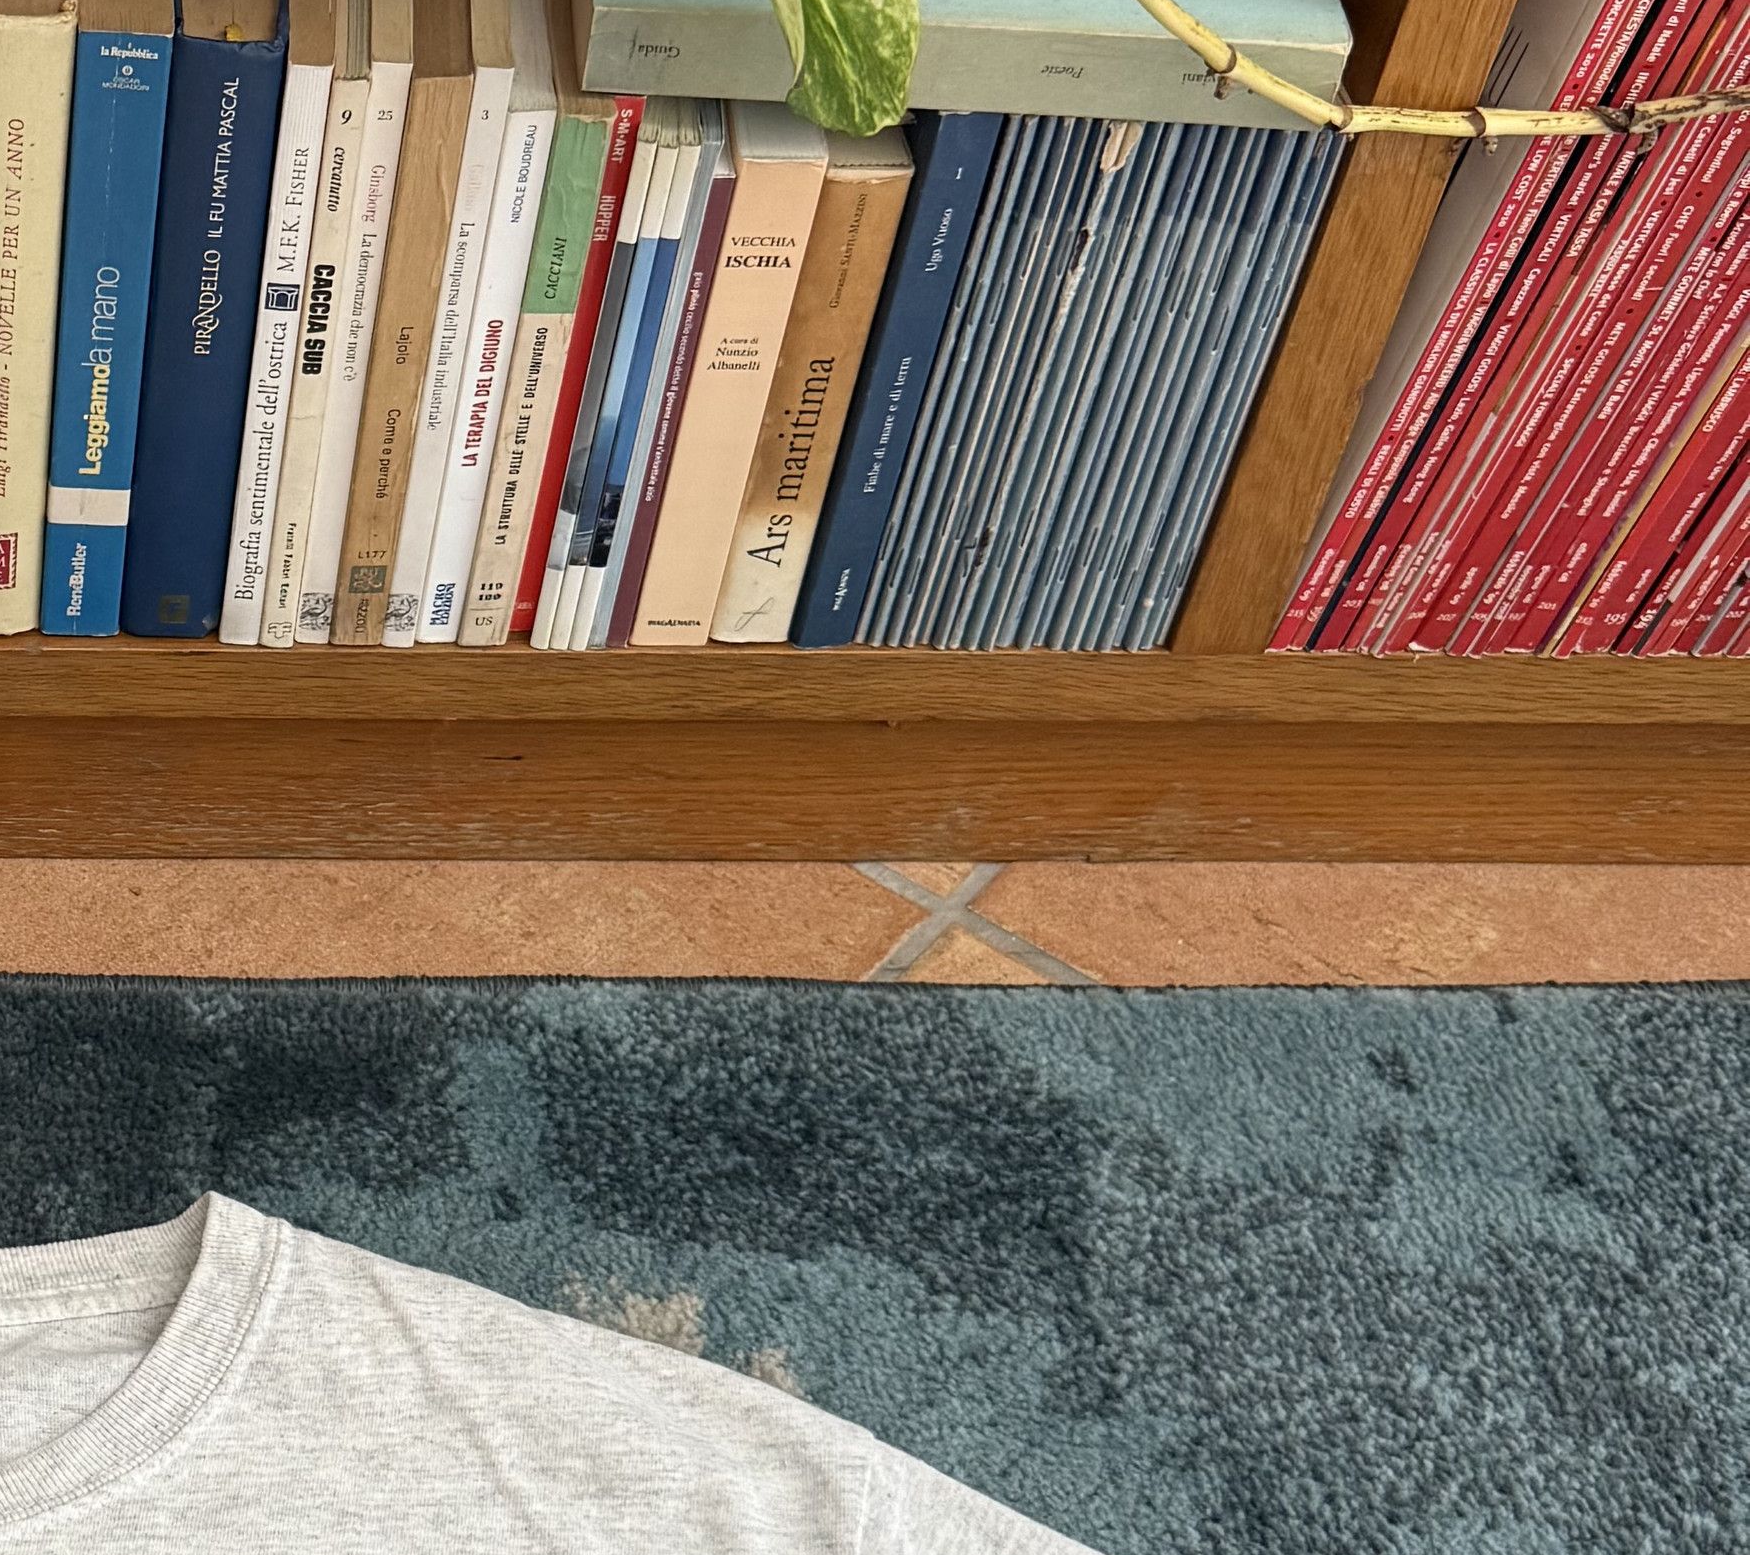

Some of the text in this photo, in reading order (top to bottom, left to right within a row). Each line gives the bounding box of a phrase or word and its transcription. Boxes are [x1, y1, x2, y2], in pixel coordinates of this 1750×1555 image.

[1666, 16, 1679, 26] di
[637, 42, 681, 60] Guida
[1646, 30, 1674, 62] Natale
[1040, 62, 1085, 81] Poesie
[1576, 52, 1595, 78] 2010
[340, 109, 353, 126] 9
[377, 109, 393, 121] 25
[6, 118, 24, 180] ANNO
[4, 187, 21, 216] UN
[192, 78, 240, 354] PIRANDELLO IL FU MATTIA PASCAL
[2, 224, 20, 260] PER
[731, 236, 796, 248] VECCHIA
[300, 146, 345, 378] cercatutto CACCIA SUB
[724, 255, 791, 269] ISCHIA
[715, 347, 759, 357] Nunzio
[462, 320, 504, 466] LA TERAPIA DEL DIGIUNO
[234, 322, 286, 600] Biografia sentimentale dell'ostrica
[747, 358, 834, 566] Ars maritima
